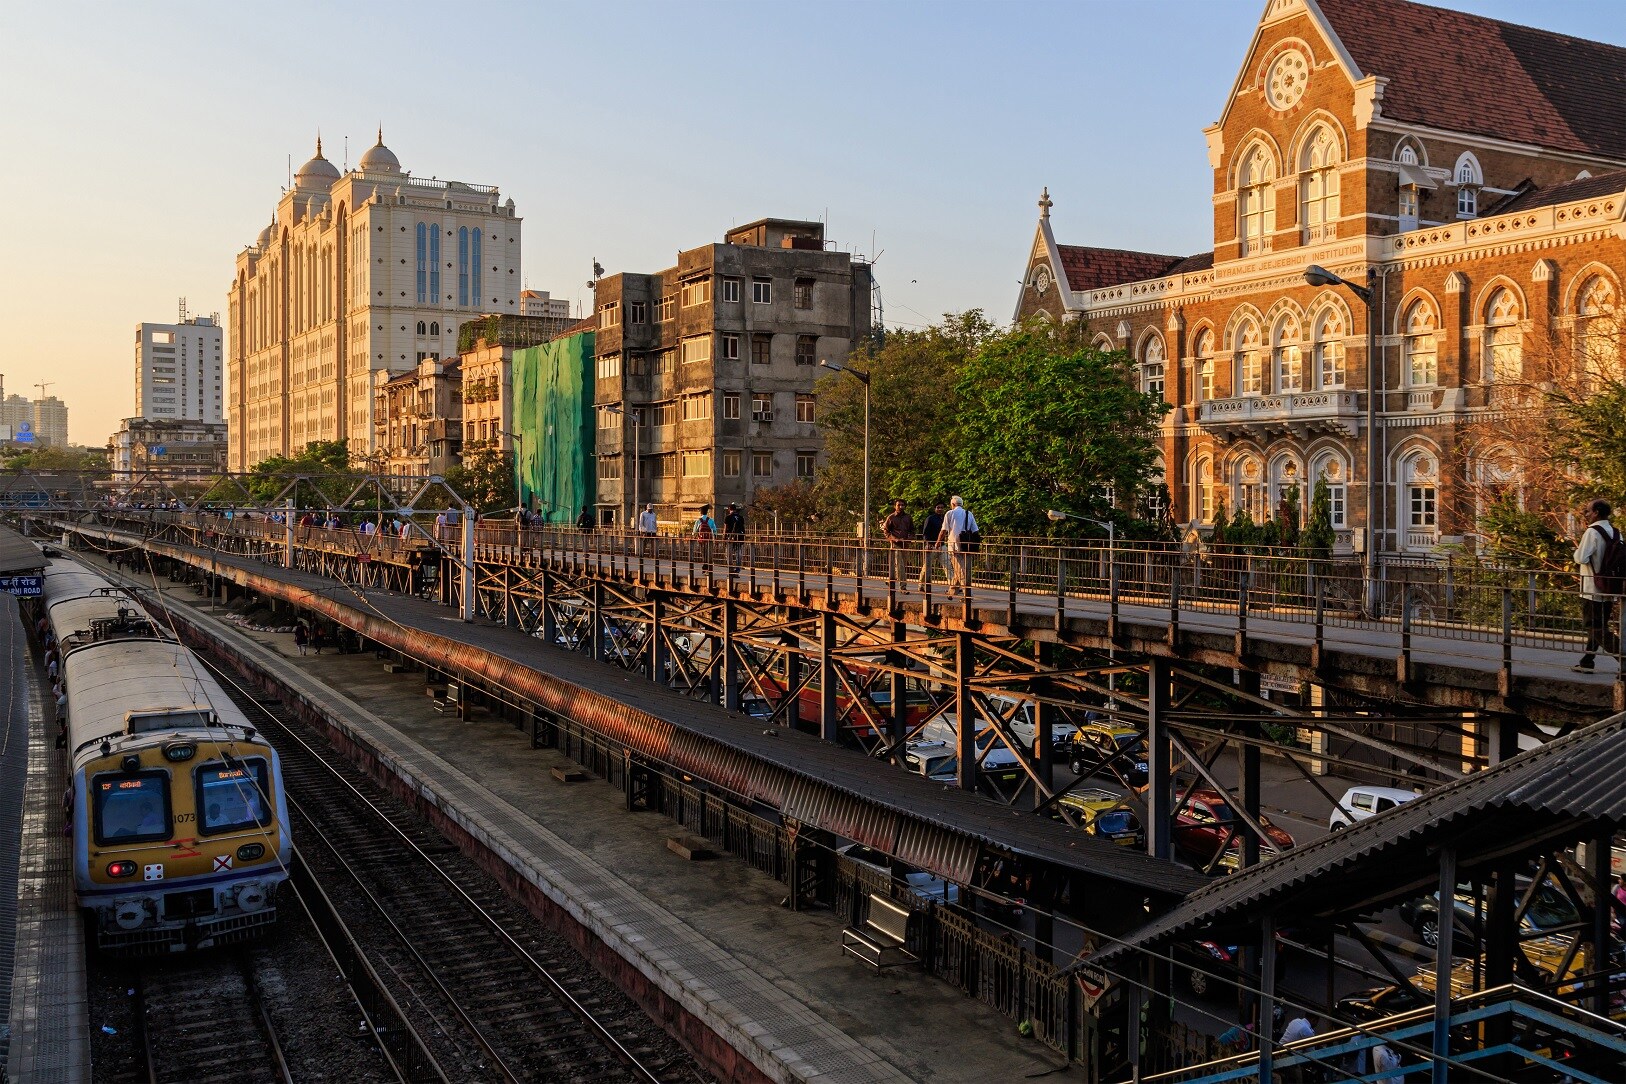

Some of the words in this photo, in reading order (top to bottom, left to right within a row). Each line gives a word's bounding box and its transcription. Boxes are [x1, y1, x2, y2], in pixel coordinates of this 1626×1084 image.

[1218, 264, 1256, 278] BYRAMJEE
[1258, 255, 1307, 271] JEEJEEBHOY
[1312, 244, 1364, 261] INSTITUTION
[20, 577, 37, 586] रोड
[173, 813, 196, 824] 1073
